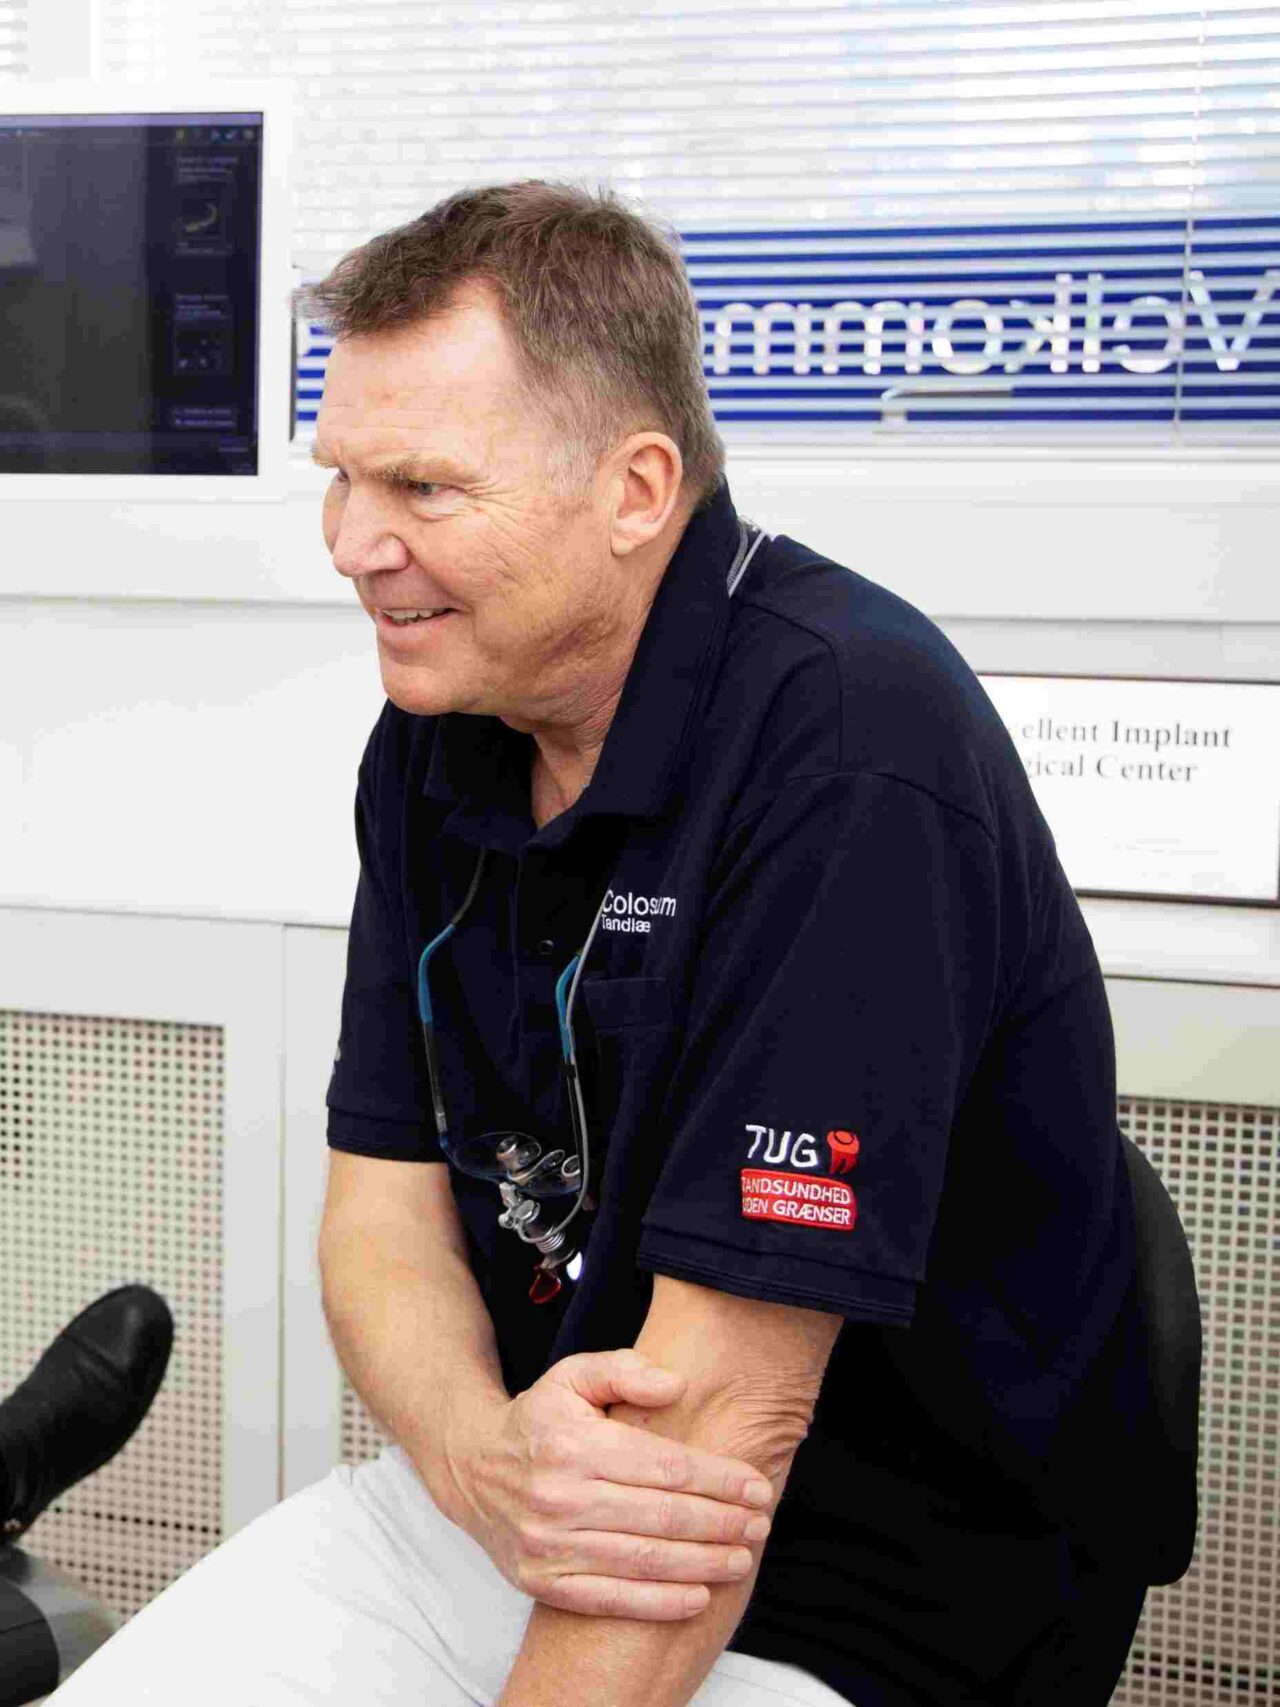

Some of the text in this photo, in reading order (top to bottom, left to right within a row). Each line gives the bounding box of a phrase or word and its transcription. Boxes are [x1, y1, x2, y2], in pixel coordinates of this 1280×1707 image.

[1021, 717, 1233, 751] ellent Implant
[1095, 755, 1199, 782] Center
[745, 1124, 819, 1168] TUG
[742, 1176, 852, 1205] TANDSUNDHED
[772, 1200, 852, 1226] GRÆNSER
